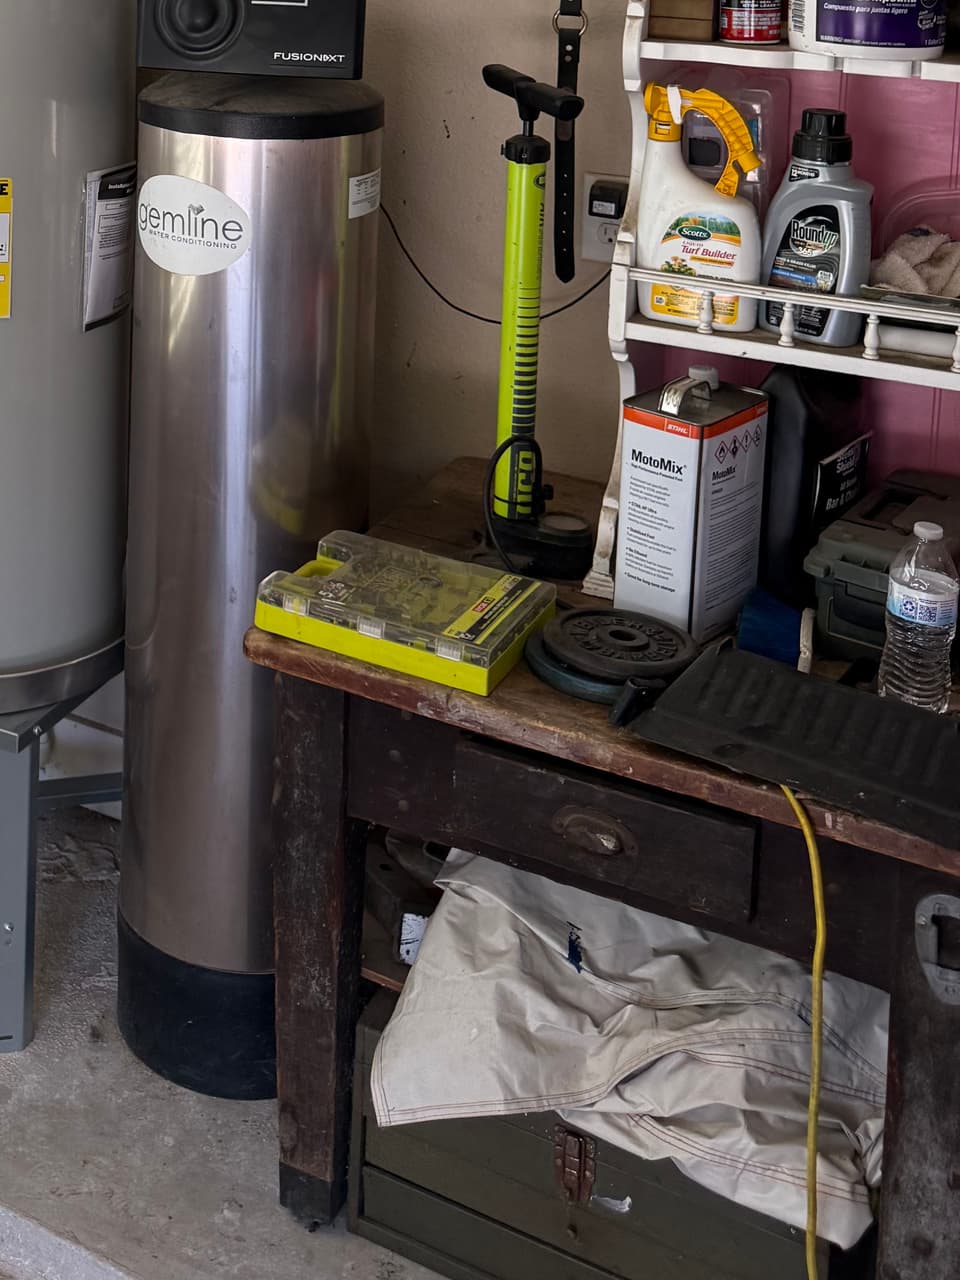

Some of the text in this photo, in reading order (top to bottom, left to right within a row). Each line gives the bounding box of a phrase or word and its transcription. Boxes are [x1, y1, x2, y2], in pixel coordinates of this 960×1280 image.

[824, 2, 855, 12] Compuesto
[791, 168, 798, 177] 12
[139, 203, 243, 242] gemline
[149, 228, 237, 250] WATER CONDITIONING
[681, 227, 708, 238] Scotts
[791, 219, 839, 251] Roundup
[681, 244, 737, 260] Turf Builder
[798, 246, 813, 256] 365
[667, 423, 689, 434] STIHL
[631, 448, 683, 475] MotoMix
